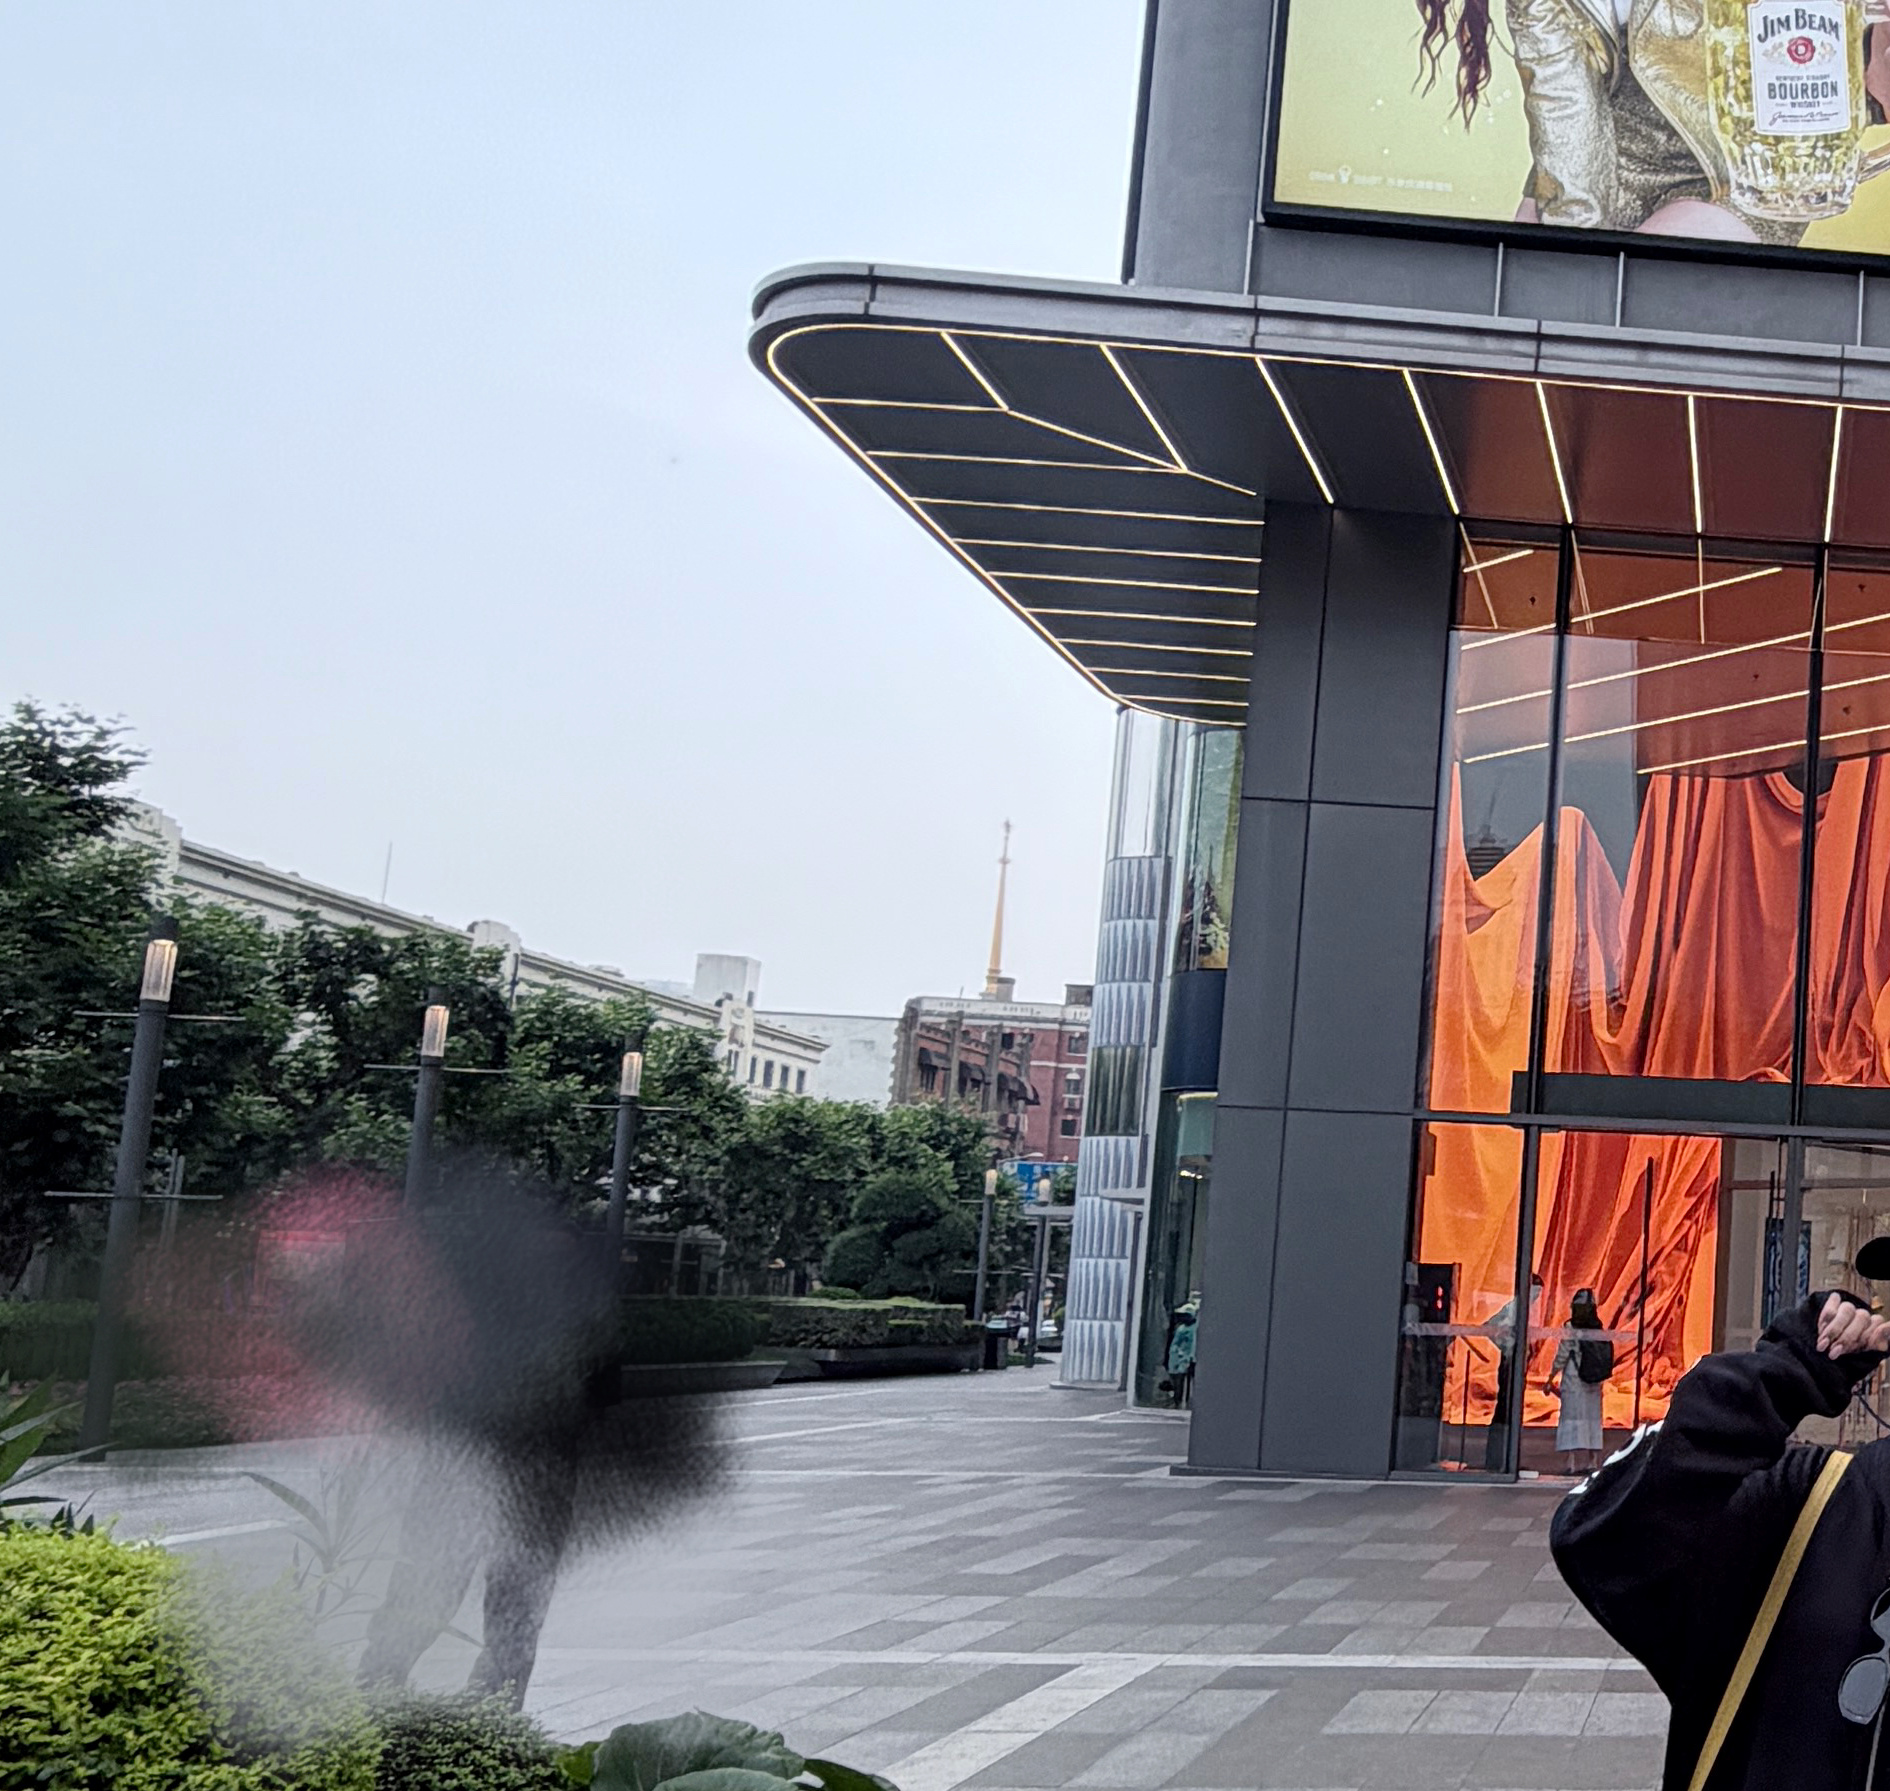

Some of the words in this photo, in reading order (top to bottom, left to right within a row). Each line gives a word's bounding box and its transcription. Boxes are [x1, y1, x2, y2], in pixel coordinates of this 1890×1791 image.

[1757, 14, 1792, 44] JIM
[1794, 8, 1840, 42] BEAM
[1767, 79, 1839, 100] BOURBON
